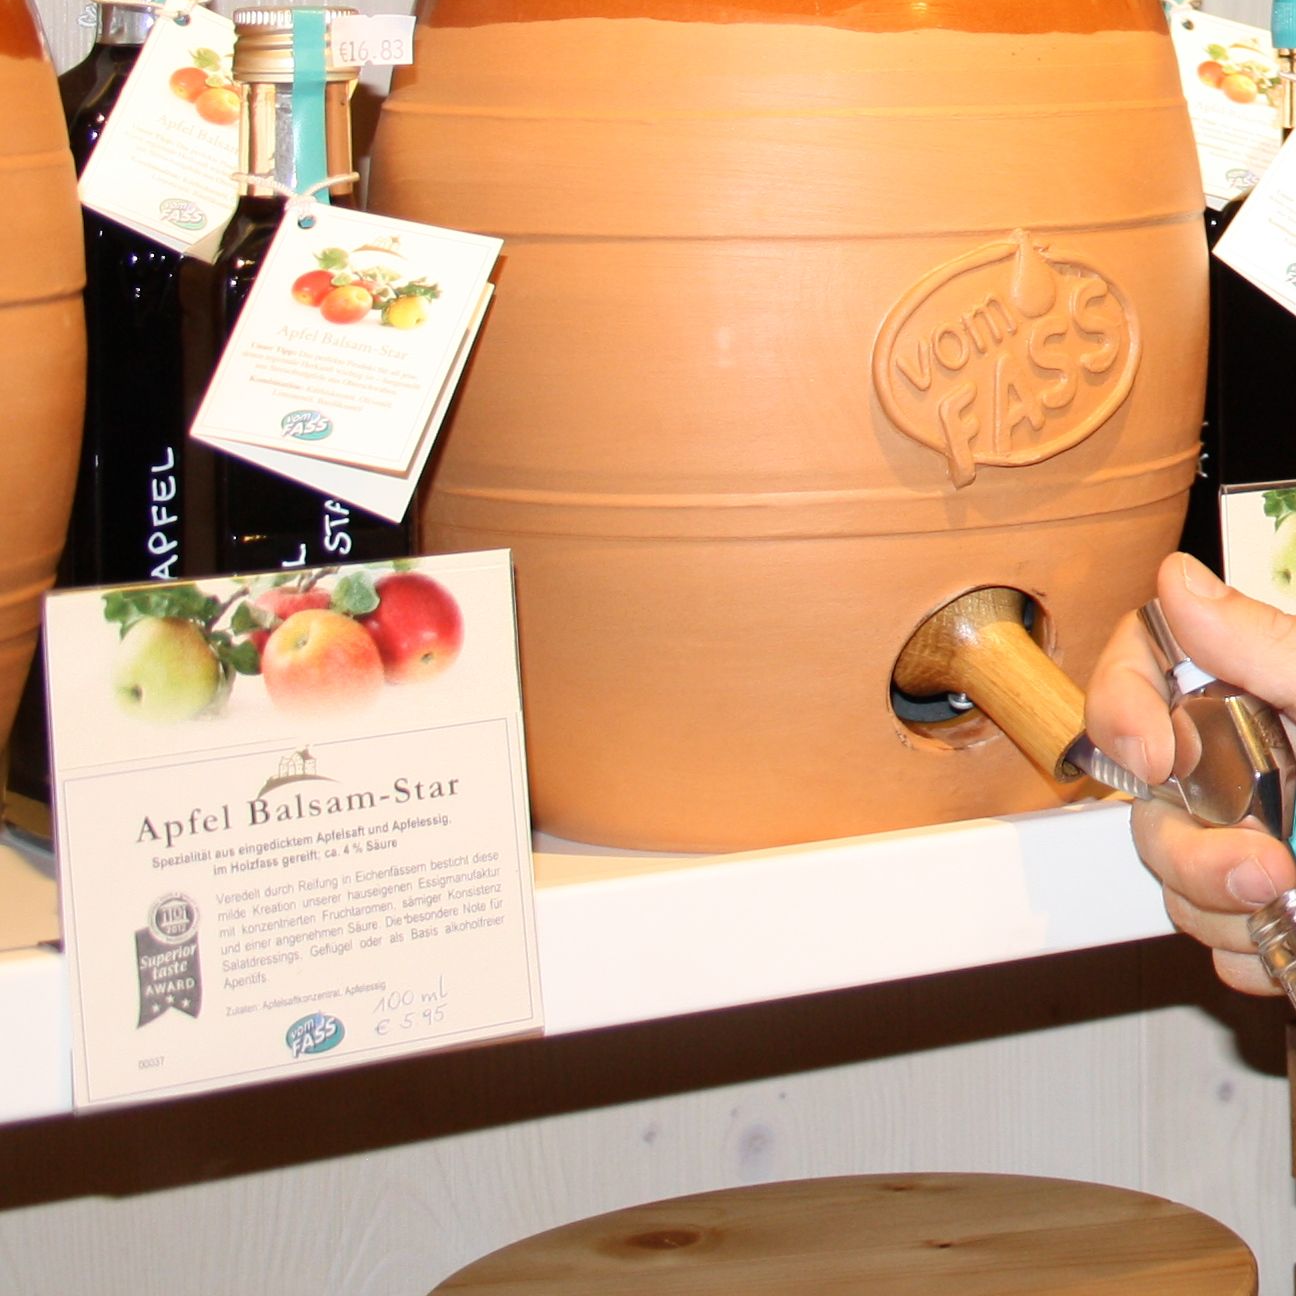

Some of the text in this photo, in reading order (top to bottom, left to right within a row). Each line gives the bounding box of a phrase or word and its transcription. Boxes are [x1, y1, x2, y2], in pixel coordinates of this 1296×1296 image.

[339, 39, 404, 63] €16.83
[277, 324, 409, 361] Apfel Balsam-Star
[896, 294, 1018, 392] vom
[938, 278, 1122, 491] FASS
[281, 415, 330, 439] FASS
[148, 446, 179, 580] APFEL
[137, 778, 457, 848] Apfel Balsam-Star
[151, 850, 211, 868] Spezialität
[214, 848, 235, 859] aus
[237, 836, 313, 855] eingedicktem
[315, 826, 365, 843] Apfelsaft
[367, 822, 389, 835] und
[212, 863, 228, 876] im
[229, 857, 279, 873] Holzfass
[342, 843, 350, 855] 4
[350, 841, 363, 854] %
[365, 839, 397, 852] Säure
[215, 852, 499, 905] Veredelt durch Reifung in Eichenfässern besticht diese
[217, 867, 500, 922] milde Kreation unserer hauseigenen Essigmanufaktur
[218, 926, 236, 938] mit
[240, 914, 316, 935] konzentrierten
[401, 892, 442, 911] sämiger
[447, 883, 501, 900] Konsistenz
[219, 942, 241, 956] und
[243, 938, 271, 952] einer
[275, 926, 343, 947] angenehmen
[383, 915, 403, 928] Die
[405, 906, 459, 924] besondere
[461, 901, 486, 915] Note
[488, 896, 503, 913] für
[138, 943, 199, 971] Superior
[309, 939, 353, 957] Geflügel
[358, 935, 382, 949] oder
[388, 932, 404, 944] als
[409, 925, 438, 940] Basis
[444, 915, 504, 934] alkoholfreier
[144, 978, 197, 997] AWARD
[151, 961, 189, 982] taste
[372, 974, 449, 1014] 100 ml
[287, 1019, 317, 1042] vom
[288, 1017, 339, 1061] FASS
